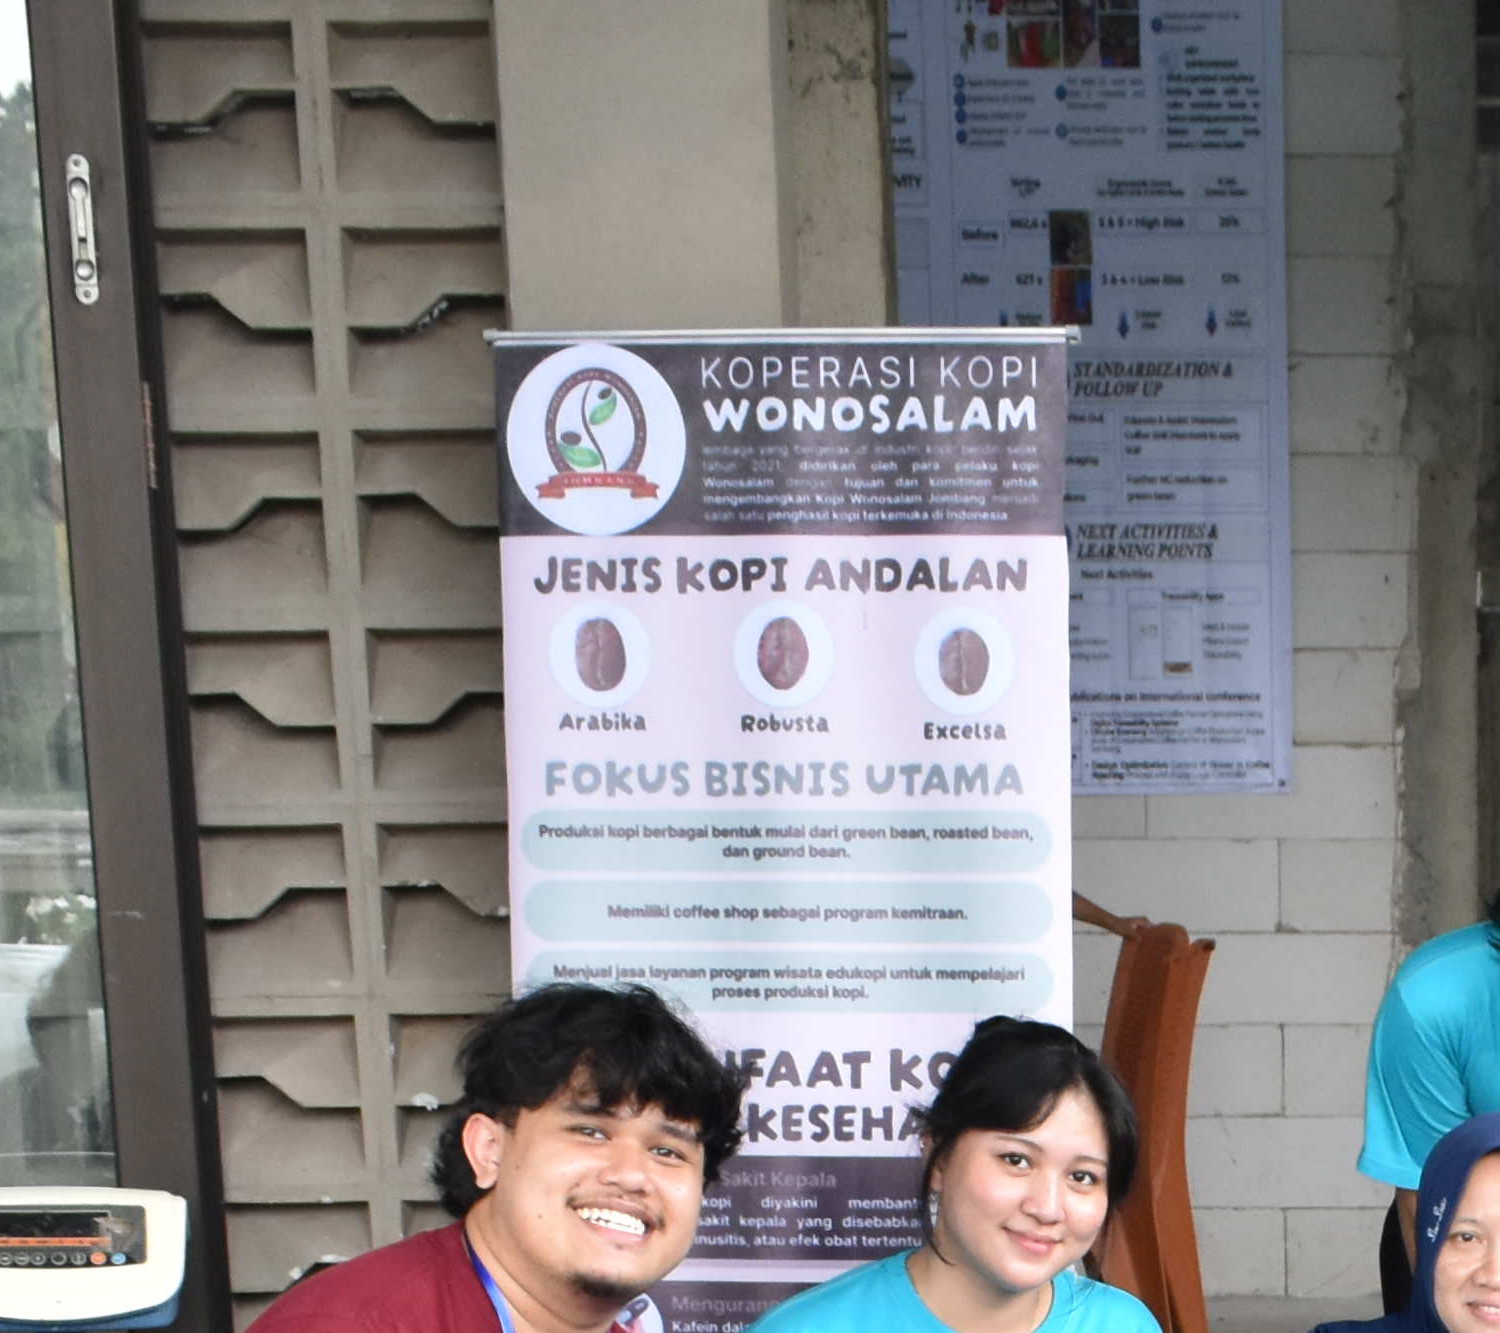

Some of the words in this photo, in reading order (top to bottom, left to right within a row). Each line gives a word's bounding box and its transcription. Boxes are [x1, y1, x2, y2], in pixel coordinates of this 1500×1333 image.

[701, 356, 915, 389] KOPERASI
[940, 356, 1037, 389] KOPI
[1073, 361, 1219, 378] STANDARDIZATION
[1222, 361, 1234, 378] &
[1074, 381, 1138, 397] FOLLOW
[1142, 381, 1164, 397] UP
[703, 394, 1037, 434] WONOSALAM
[1076, 524, 1116, 540] NEXT
[1120, 524, 1205, 540] ACTIVITIES
[1207, 524, 1219, 540] &
[1077, 543, 1155, 560] LEARNING
[1158, 543, 1213, 560] POINTS
[534, 556, 662, 594] JENIS
[676, 556, 789, 594] KOPI
[804, 556, 1028, 594] ANDALAN
[559, 712, 647, 732] Arabika
[740, 713, 830, 734] Robusta
[923, 721, 1007, 741] Excelsa
[545, 761, 690, 797] FOKUS
[704, 761, 850, 797] BISNIS
[865, 761, 1025, 797] UTAMA
[538, 824, 604, 842] Produksi
[607, 824, 639, 842] kopi
[643, 824, 708, 842] berbagai
[711, 824, 762, 842] bentuk
[765, 824, 805, 842] mulai
[809, 824, 838, 842] dari
[842, 824, 885, 842] green
[889, 824, 930, 842] bean,
[933, 824, 989, 842] roasted
[992, 824, 1033, 842] bean,
[722, 844, 749, 860] dan
[752, 844, 805, 860] ground
[808, 844, 851, 860] bean.
[607, 904, 669, 922] Memiliki
[672, 904, 720, 922] coffee
[723, 904, 759, 922] shop
[762, 904, 820, 922] sebagai
[823, 904, 888, 922] program
[891, 904, 968, 922] kemitraan.
[553, 964, 613, 983] Menjual
[614, 964, 646, 983] jasa
[649, 964, 706, 983] layanan
[709, 964, 770, 983] program
[773, 964, 822, 983] wisata
[825, 964, 887, 983] edukopi
[889, 964, 932, 983] untuk
[935, 964, 1025, 983] mempelajari
[711, 984, 760, 1001] proses
[764, 984, 829, 1001] produksi
[832, 984, 869, 1001] kopi.
[725, 1048, 871, 1090] FAAT
[719, 1172, 766, 1190] Sakit
[771, 1172, 837, 1190] Kepala
[760, 1195, 818, 1211] diyakini
[739, 1214, 787, 1230] kepala
[797, 1214, 832, 1230] yang
[753, 1234, 786, 1248] atau
[789, 1234, 820, 1248] efek
[824, 1234, 858, 1248] obat
[862, 1234, 923, 1248] tertentu
[672, 1320, 718, 1333] Kafein
